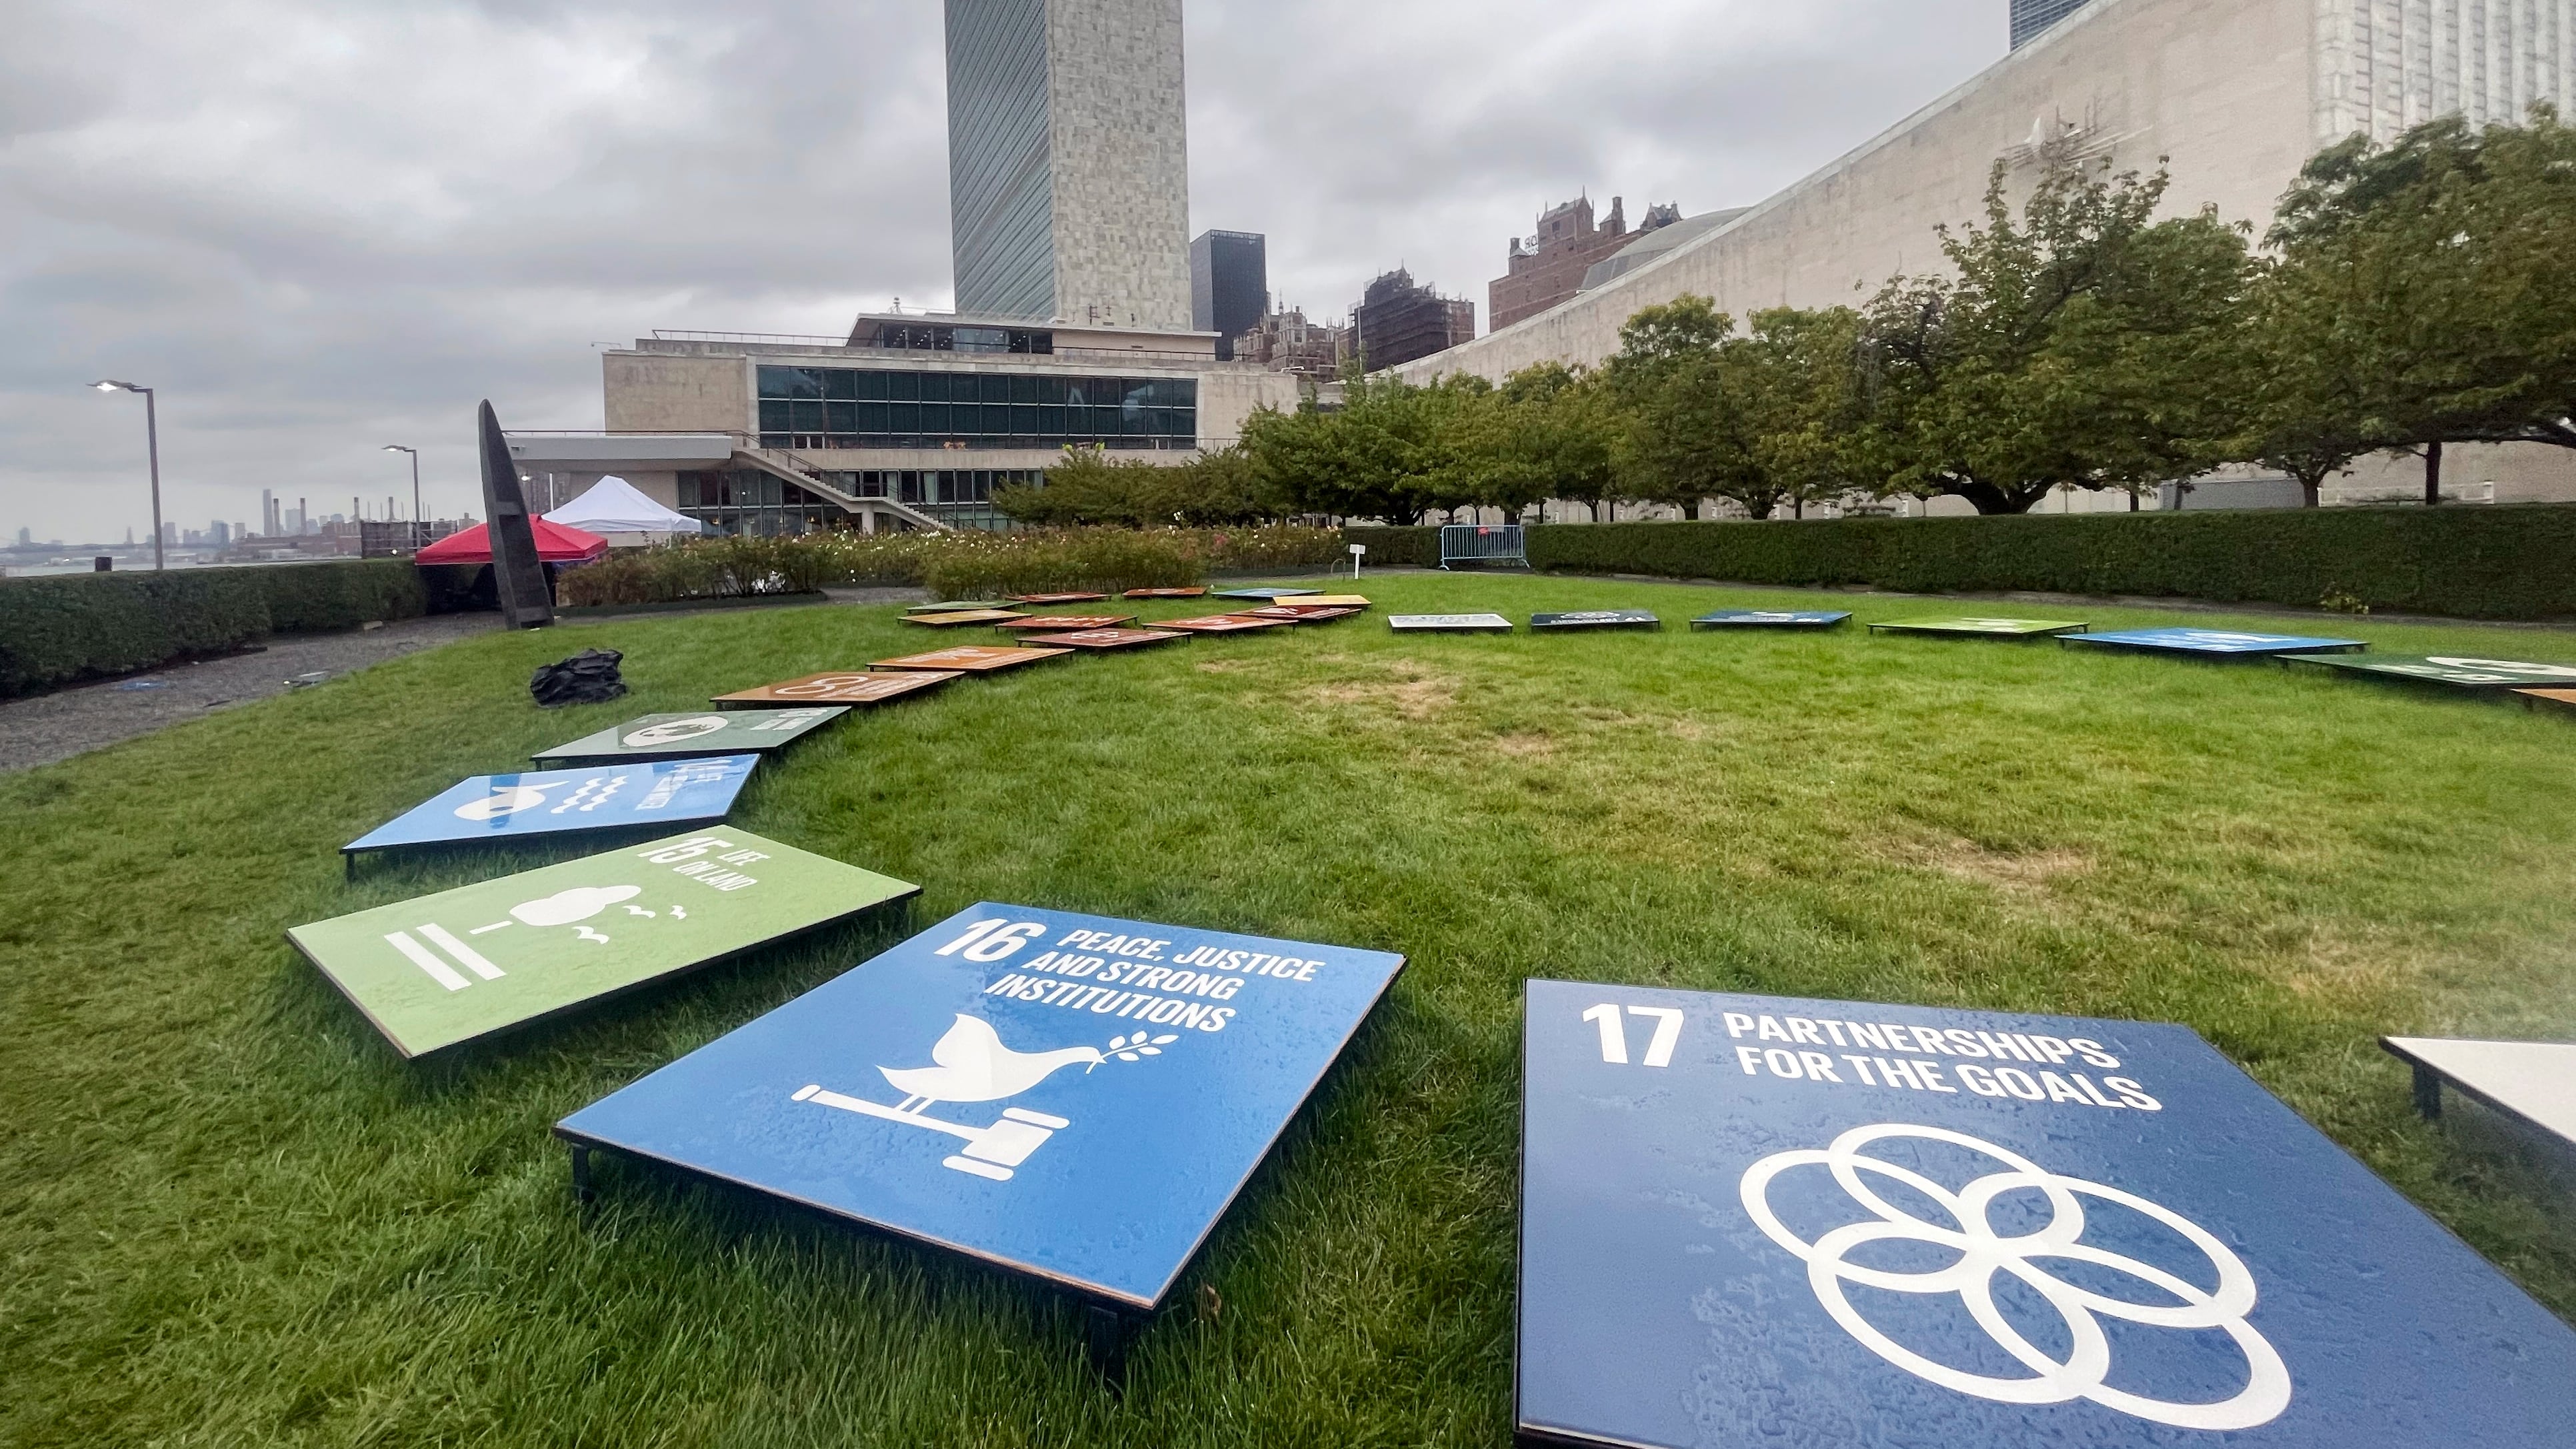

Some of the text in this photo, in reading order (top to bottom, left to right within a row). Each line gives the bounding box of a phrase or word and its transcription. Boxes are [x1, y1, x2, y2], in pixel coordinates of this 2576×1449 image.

[637, 836, 734, 864] 15
[717, 848, 771, 866] LIFE
[673, 861, 758, 891] ON LAND
[933, 918, 1047, 962] 16
[1056, 929, 1327, 982] PEACE, JUSTICE
[1021, 951, 1245, 1001] AND STRONG
[983, 973, 1237, 1033] INSTITUTIONS
[1581, 1002, 1685, 1068] 17
[1723, 1011, 2121, 1069] PARTNERSHIPS
[1735, 1045, 2163, 1111] FOR THE GOALS
